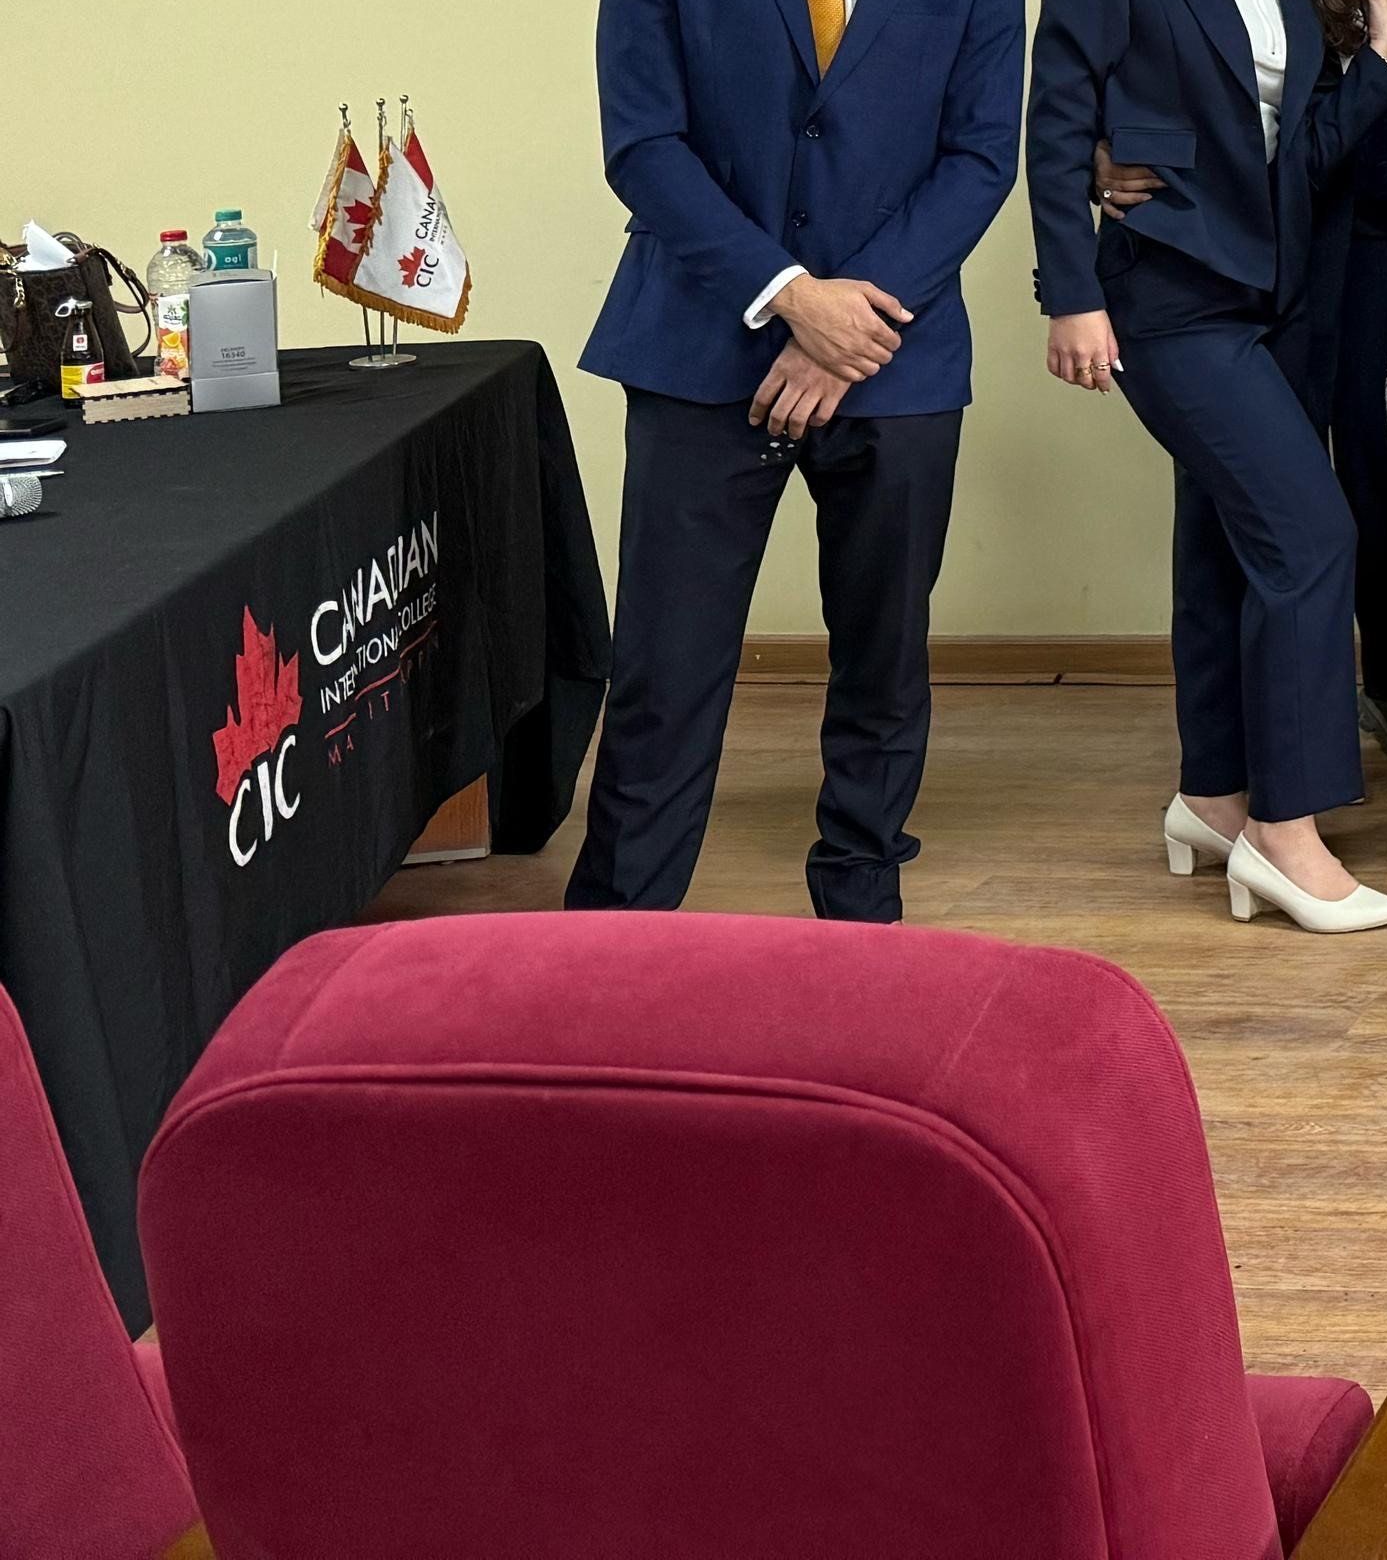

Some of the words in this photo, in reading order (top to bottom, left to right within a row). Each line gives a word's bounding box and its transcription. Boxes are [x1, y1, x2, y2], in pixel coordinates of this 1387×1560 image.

[416, 254, 440, 288] CIC
[310, 511, 438, 666] CANADIAN
[228, 734, 301, 867] CIC
